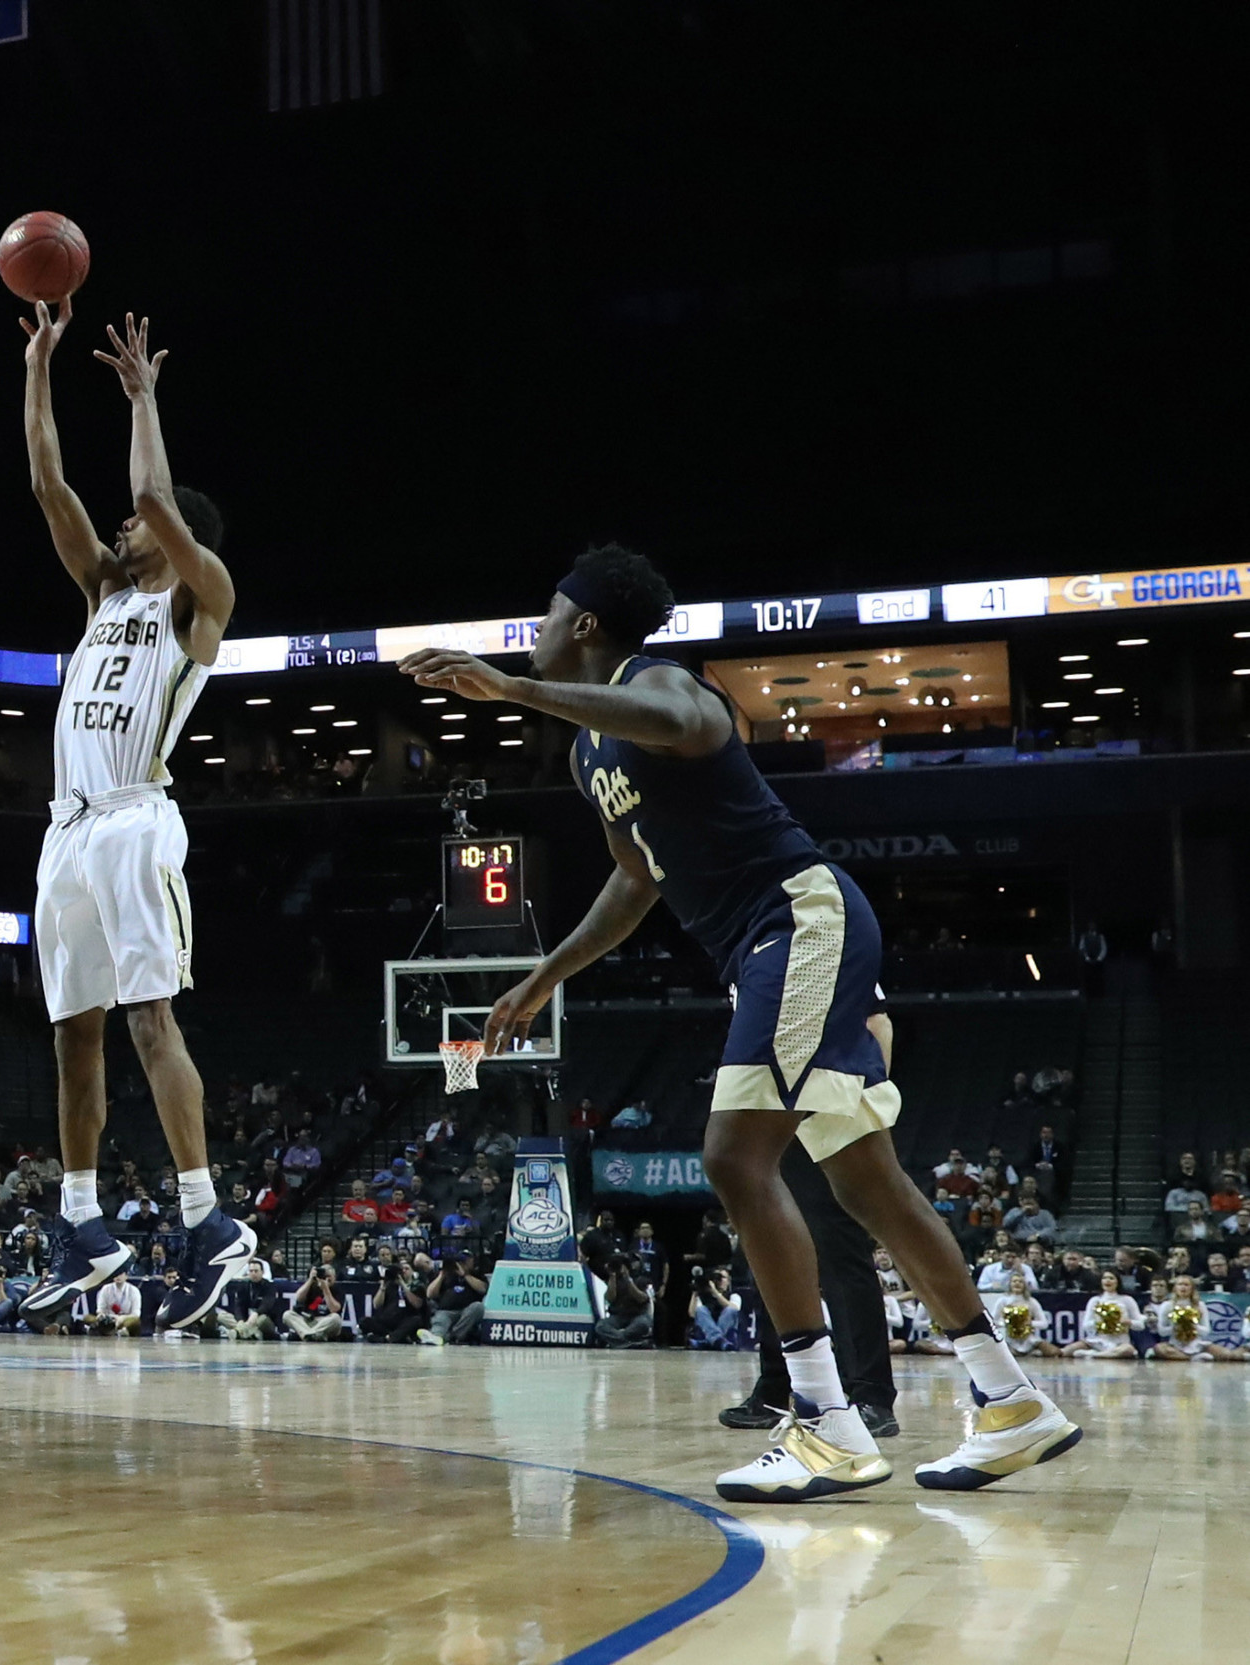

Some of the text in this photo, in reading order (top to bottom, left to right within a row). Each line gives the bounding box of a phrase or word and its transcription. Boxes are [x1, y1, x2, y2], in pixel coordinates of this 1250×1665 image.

[1132, 569, 1241, 603] GEORGIA
[871, 595, 915, 620] 2nd
[980, 587, 1006, 612] 41
[752, 597, 822, 632] 10:17
[288, 634, 330, 651] FLS: 4
[288, 652, 315, 667] TOL:
[91, 655, 131, 692] 12
[73, 701, 134, 734] TECH
[591, 766, 641, 822] Pitt
[461, 845, 512, 868] 10:17
[976, 837, 1020, 854] CLUB
[485, 867, 508, 903] 6
[645, 1158, 711, 1186] #AC
[527, 1211, 557, 1221] ACC
